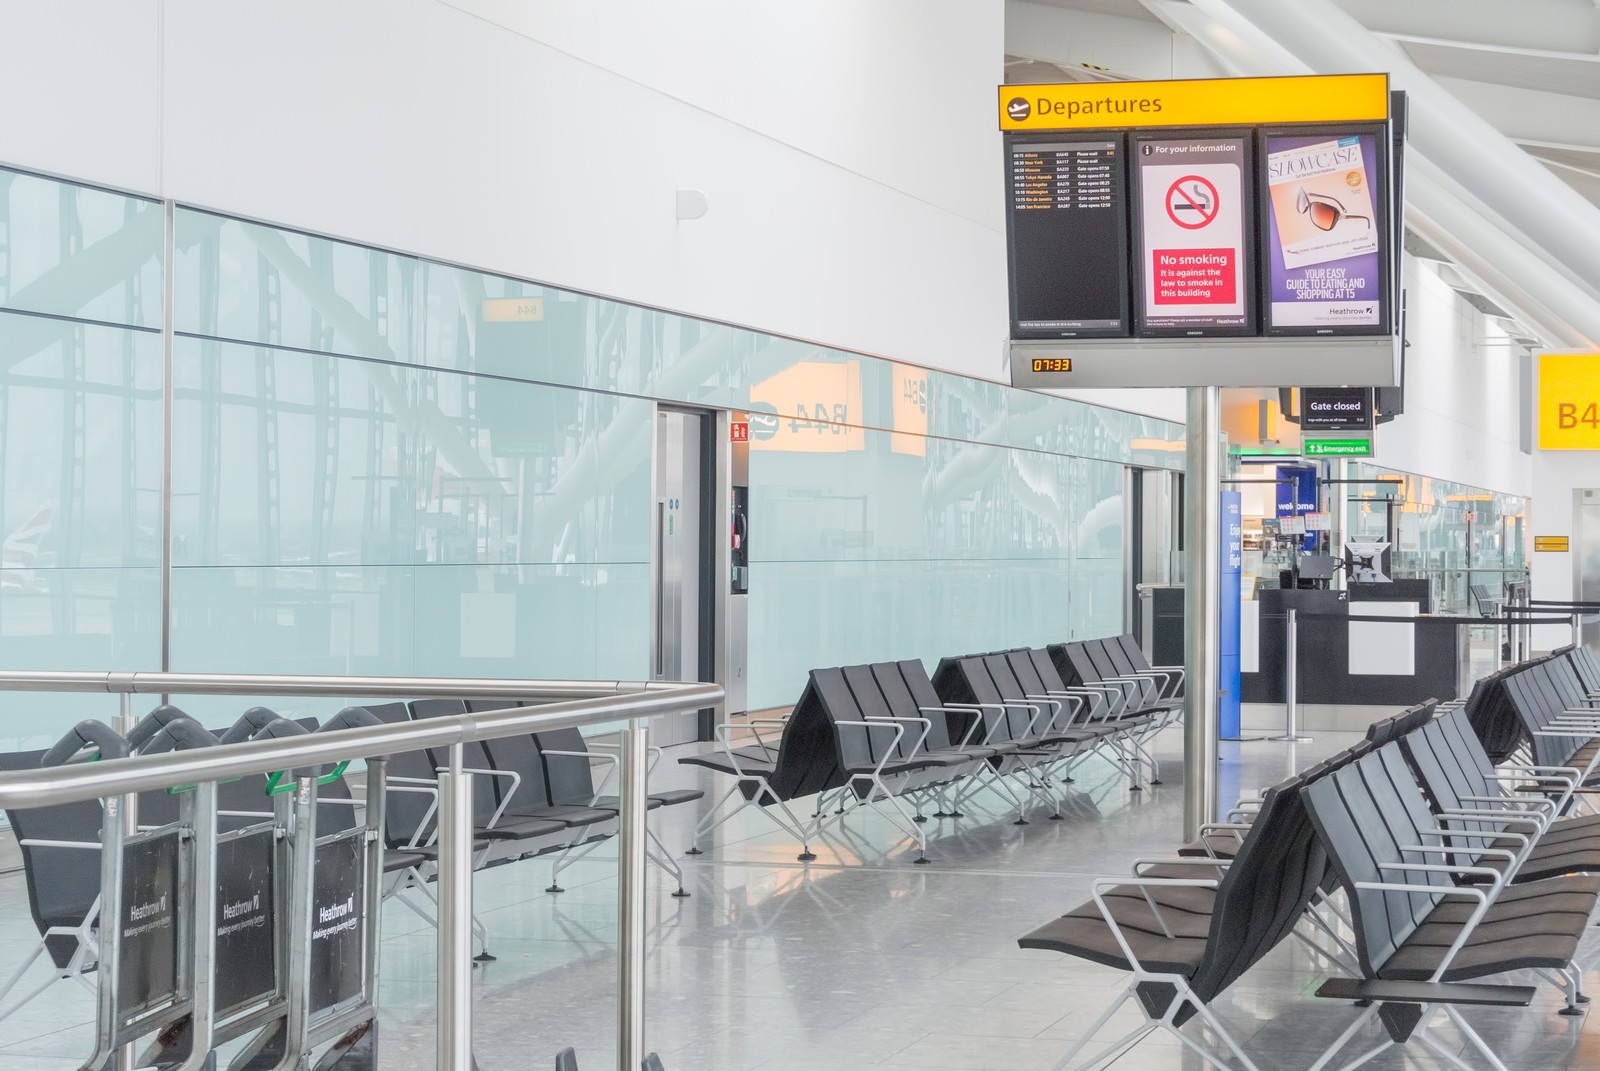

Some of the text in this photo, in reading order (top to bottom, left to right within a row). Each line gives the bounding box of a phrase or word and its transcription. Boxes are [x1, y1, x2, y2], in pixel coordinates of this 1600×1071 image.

[1037, 98, 1162, 119] Departures
[1190, 144, 1236, 152] information
[1269, 147, 1358, 178] SHOWCASE
[1160, 254, 1227, 266] No smoking
[1176, 269, 1206, 278] against
[1304, 268, 1346, 279] YOUR EASY
[1286, 278, 1365, 290] GUIDE TO EATING AND
[1178, 289, 1211, 297] building
[1296, 289, 1355, 299] SHOPPING AT T5
[1034, 360, 1070, 371] 07:33
[1310, 402, 1361, 411] Gate closed
[130, 902, 160, 921] Heathrow
[223, 900, 252, 920] Heathrow
[320, 903, 348, 923] Heathrow
[124, 927, 138, 937] Making
[218, 926, 230, 936] Making
[313, 929, 327, 939] Making
